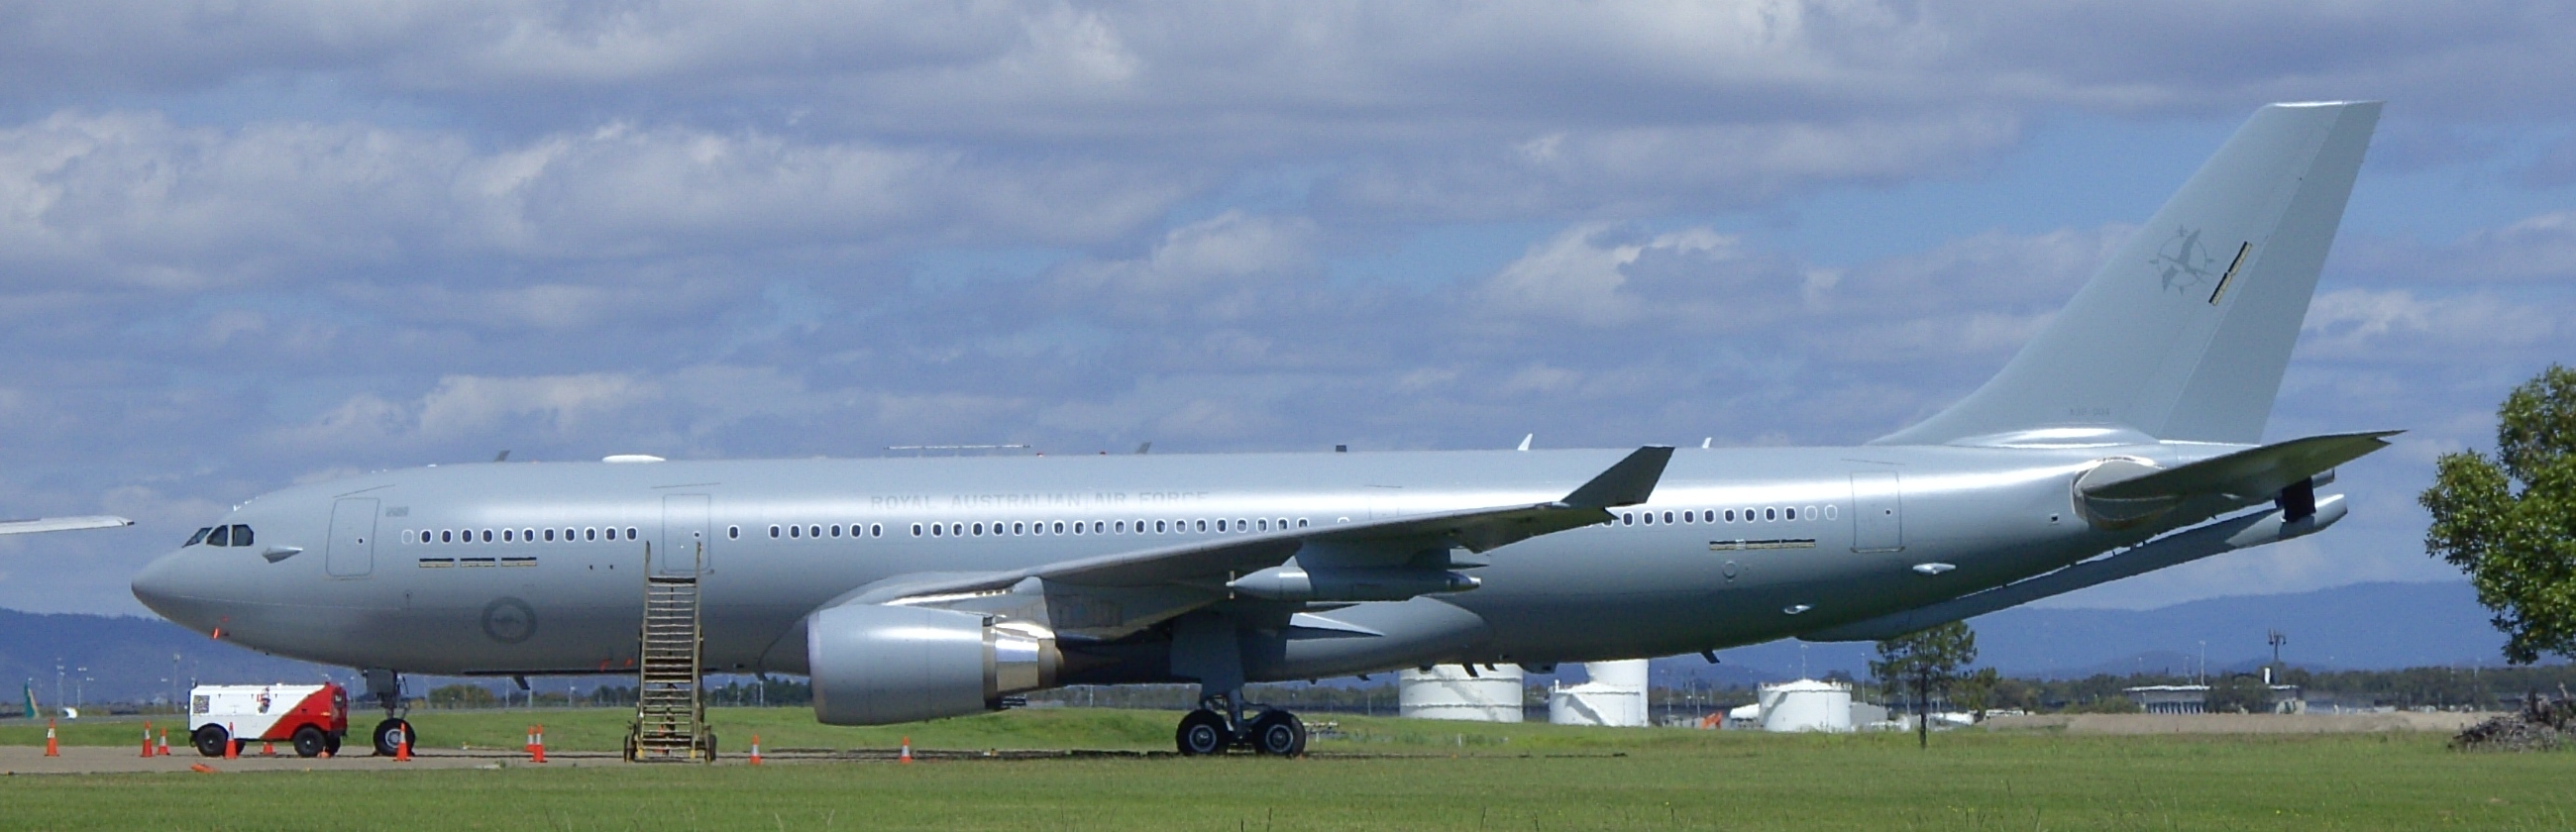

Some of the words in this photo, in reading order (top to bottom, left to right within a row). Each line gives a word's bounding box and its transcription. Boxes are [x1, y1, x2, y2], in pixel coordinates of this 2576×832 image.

[871, 495, 937, 510] ROYAL
[951, 492, 1080, 509] AUSTRALIAN
[1095, 491, 1127, 506] AIR
